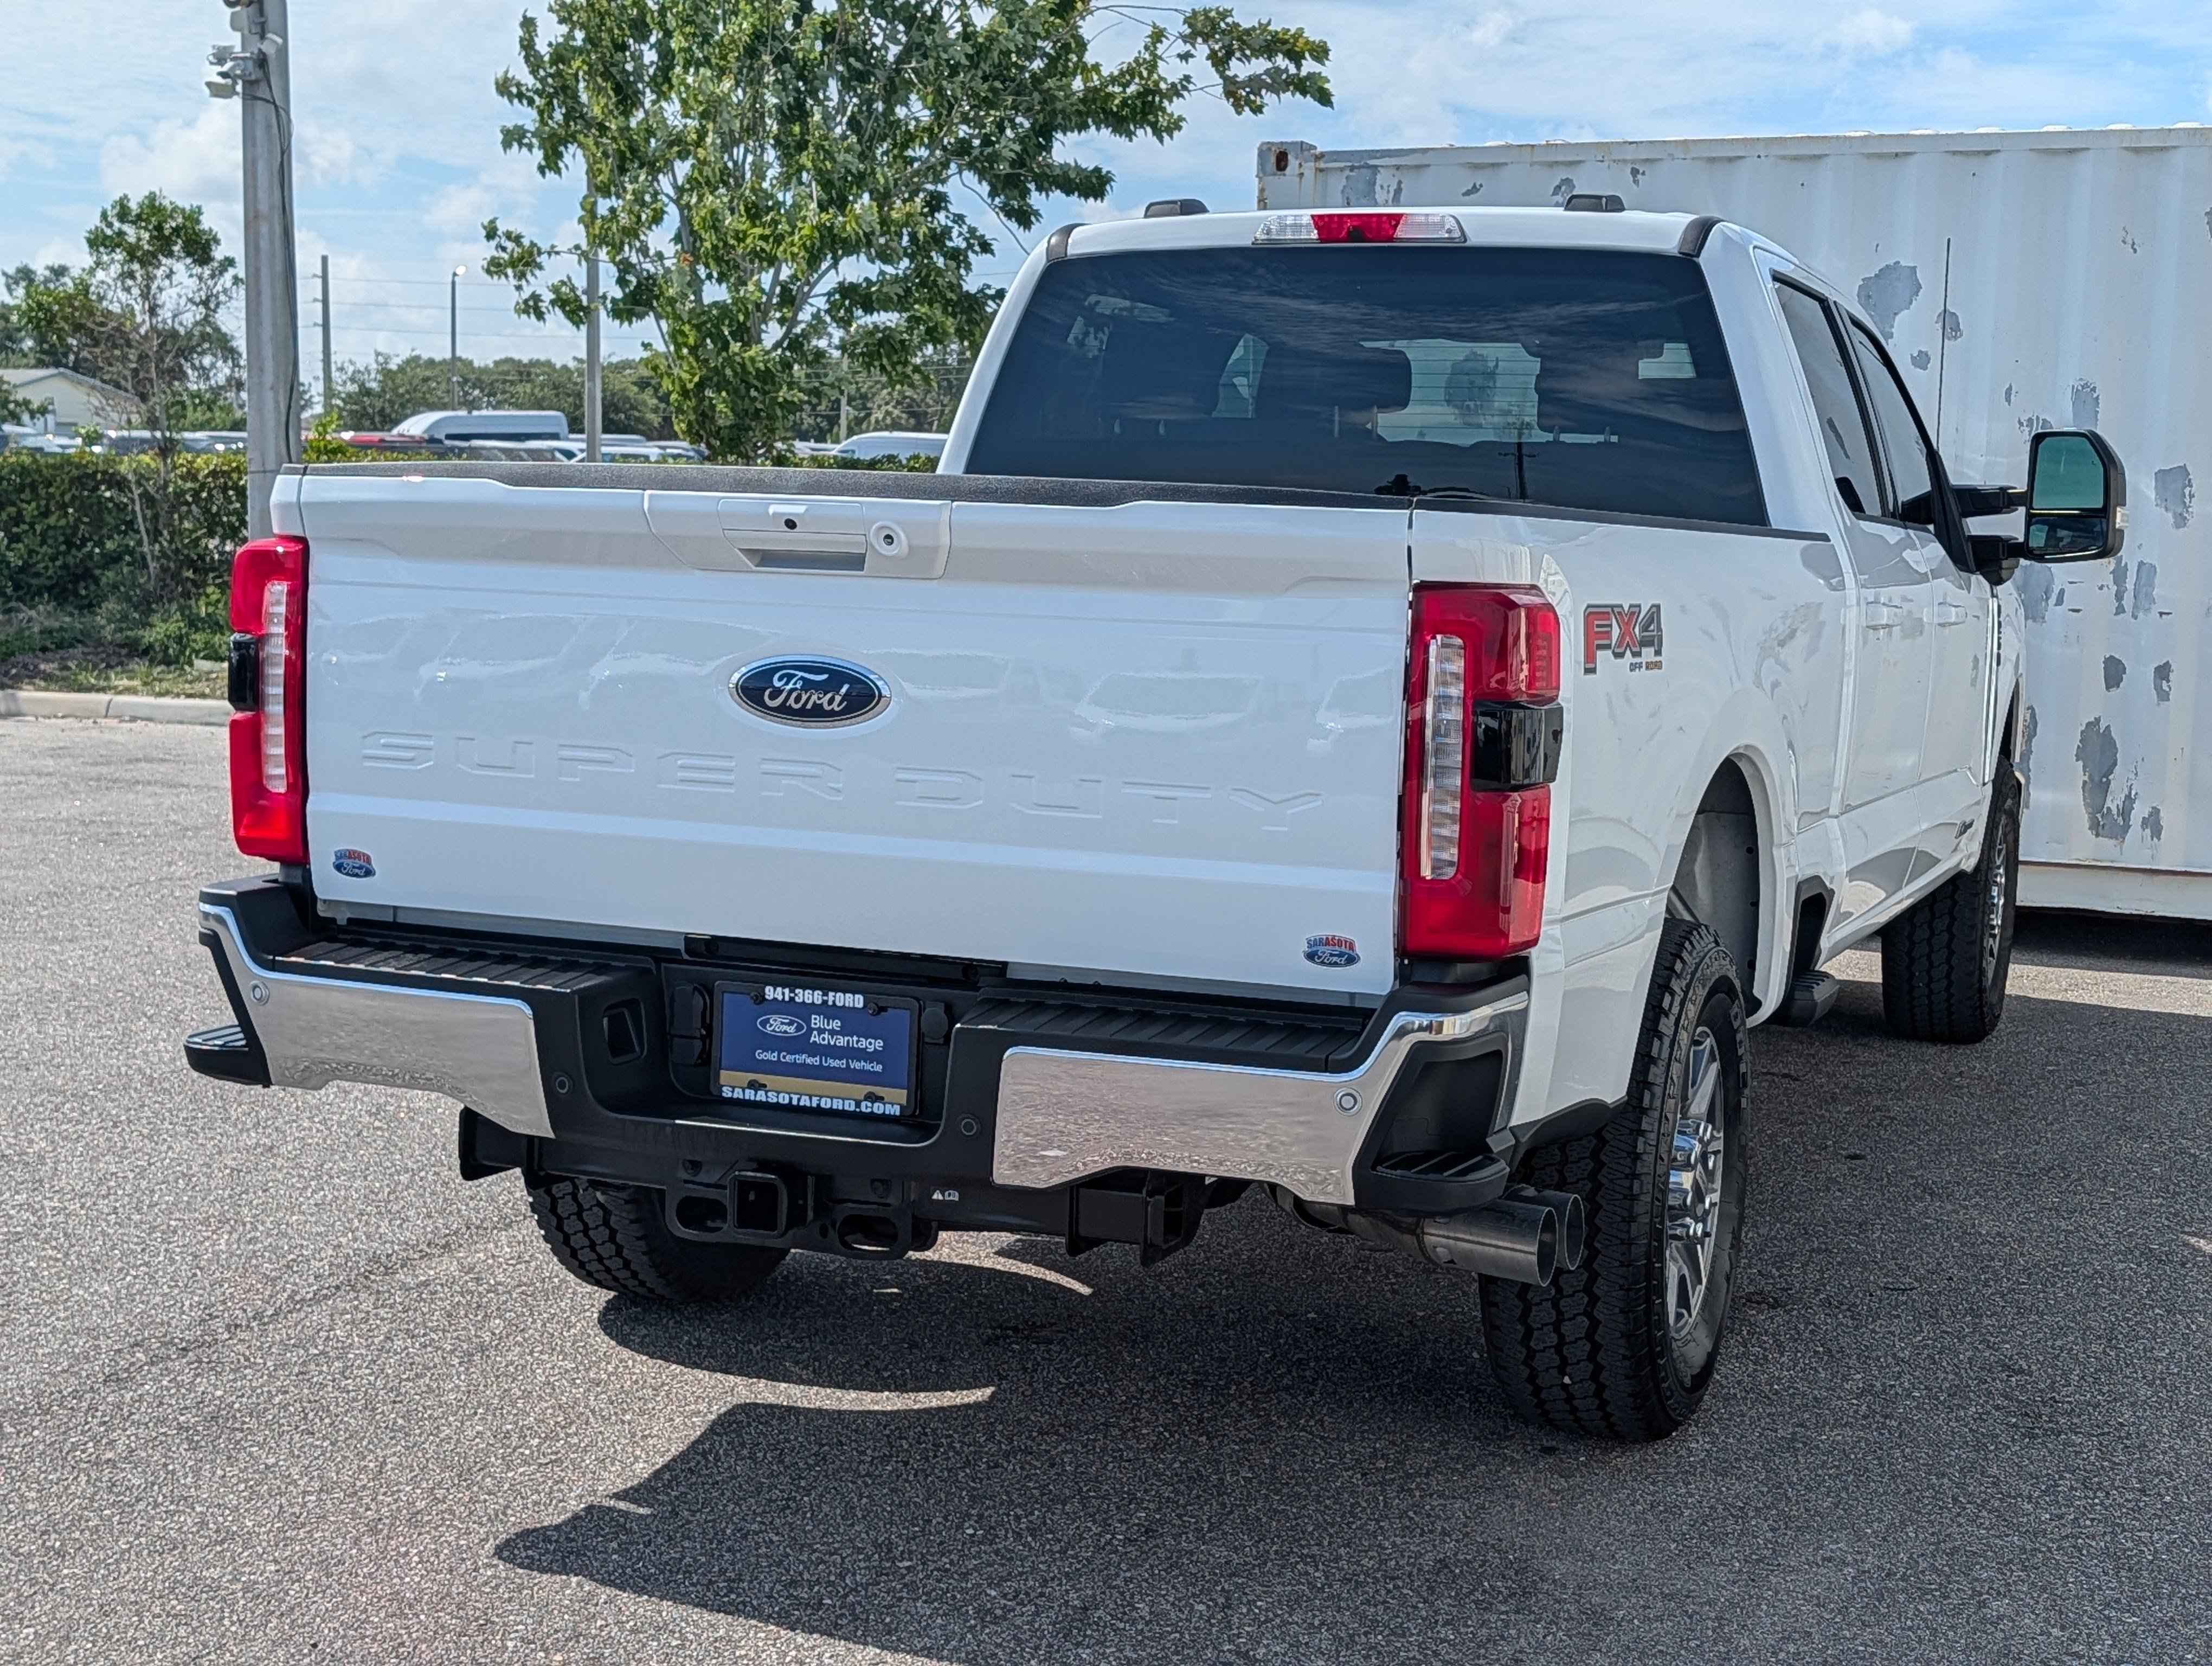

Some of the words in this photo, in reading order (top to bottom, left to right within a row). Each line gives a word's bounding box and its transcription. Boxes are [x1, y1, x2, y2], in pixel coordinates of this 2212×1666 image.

[1583, 603, 1663, 676] FX4
[1629, 661, 1643, 672] OFF
[763, 670, 850, 712] Ford
[361, 731, 844, 800] SUPER
[895, 766, 1324, 831] DUTY
[341, 861, 366, 876] Ford
[1306, 937, 1355, 953] SARASOTA
[1314, 949, 1348, 965] Ford
[764, 985, 864, 1009] 941-366-FORD
[766, 1017, 798, 1034] Ford
[811, 1014, 841, 1030] Blue
[809, 1030, 884, 1052] Advantage
[755, 1049, 778, 1062] Gold
[780, 1052, 820, 1066] Certified
[821, 1056, 846, 1069] Used
[848, 1059, 883, 1073] Vehicle
[722, 1086, 901, 1116] SARASOTAFORD.COM
